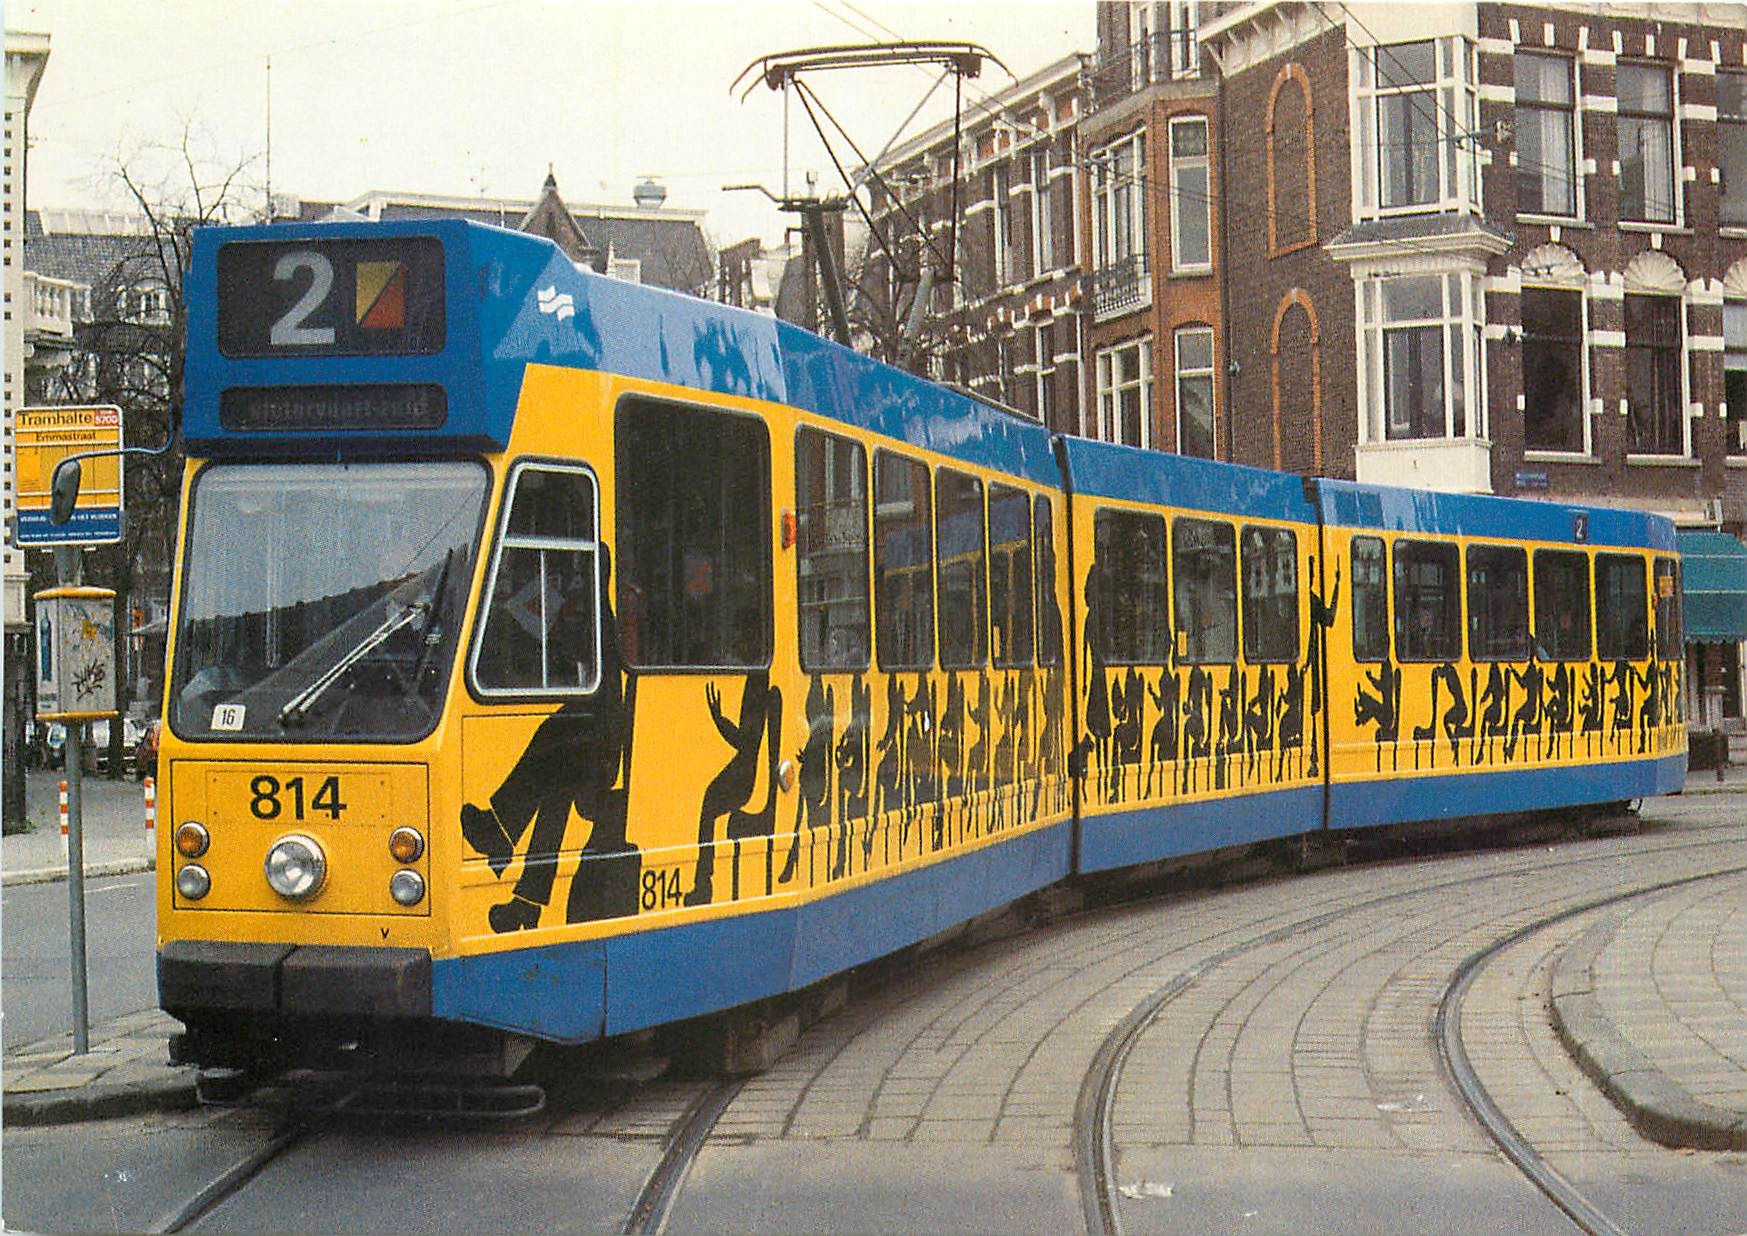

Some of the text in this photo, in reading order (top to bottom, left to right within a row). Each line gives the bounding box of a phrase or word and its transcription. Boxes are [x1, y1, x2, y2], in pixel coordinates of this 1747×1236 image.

[270, 251, 336, 346] 2
[19, 410, 92, 425] Tramhalte
[1576, 519, 1584, 539] 2
[221, 708, 235, 726] 16
[249, 775, 347, 820] 814
[641, 867, 683, 911] 814
